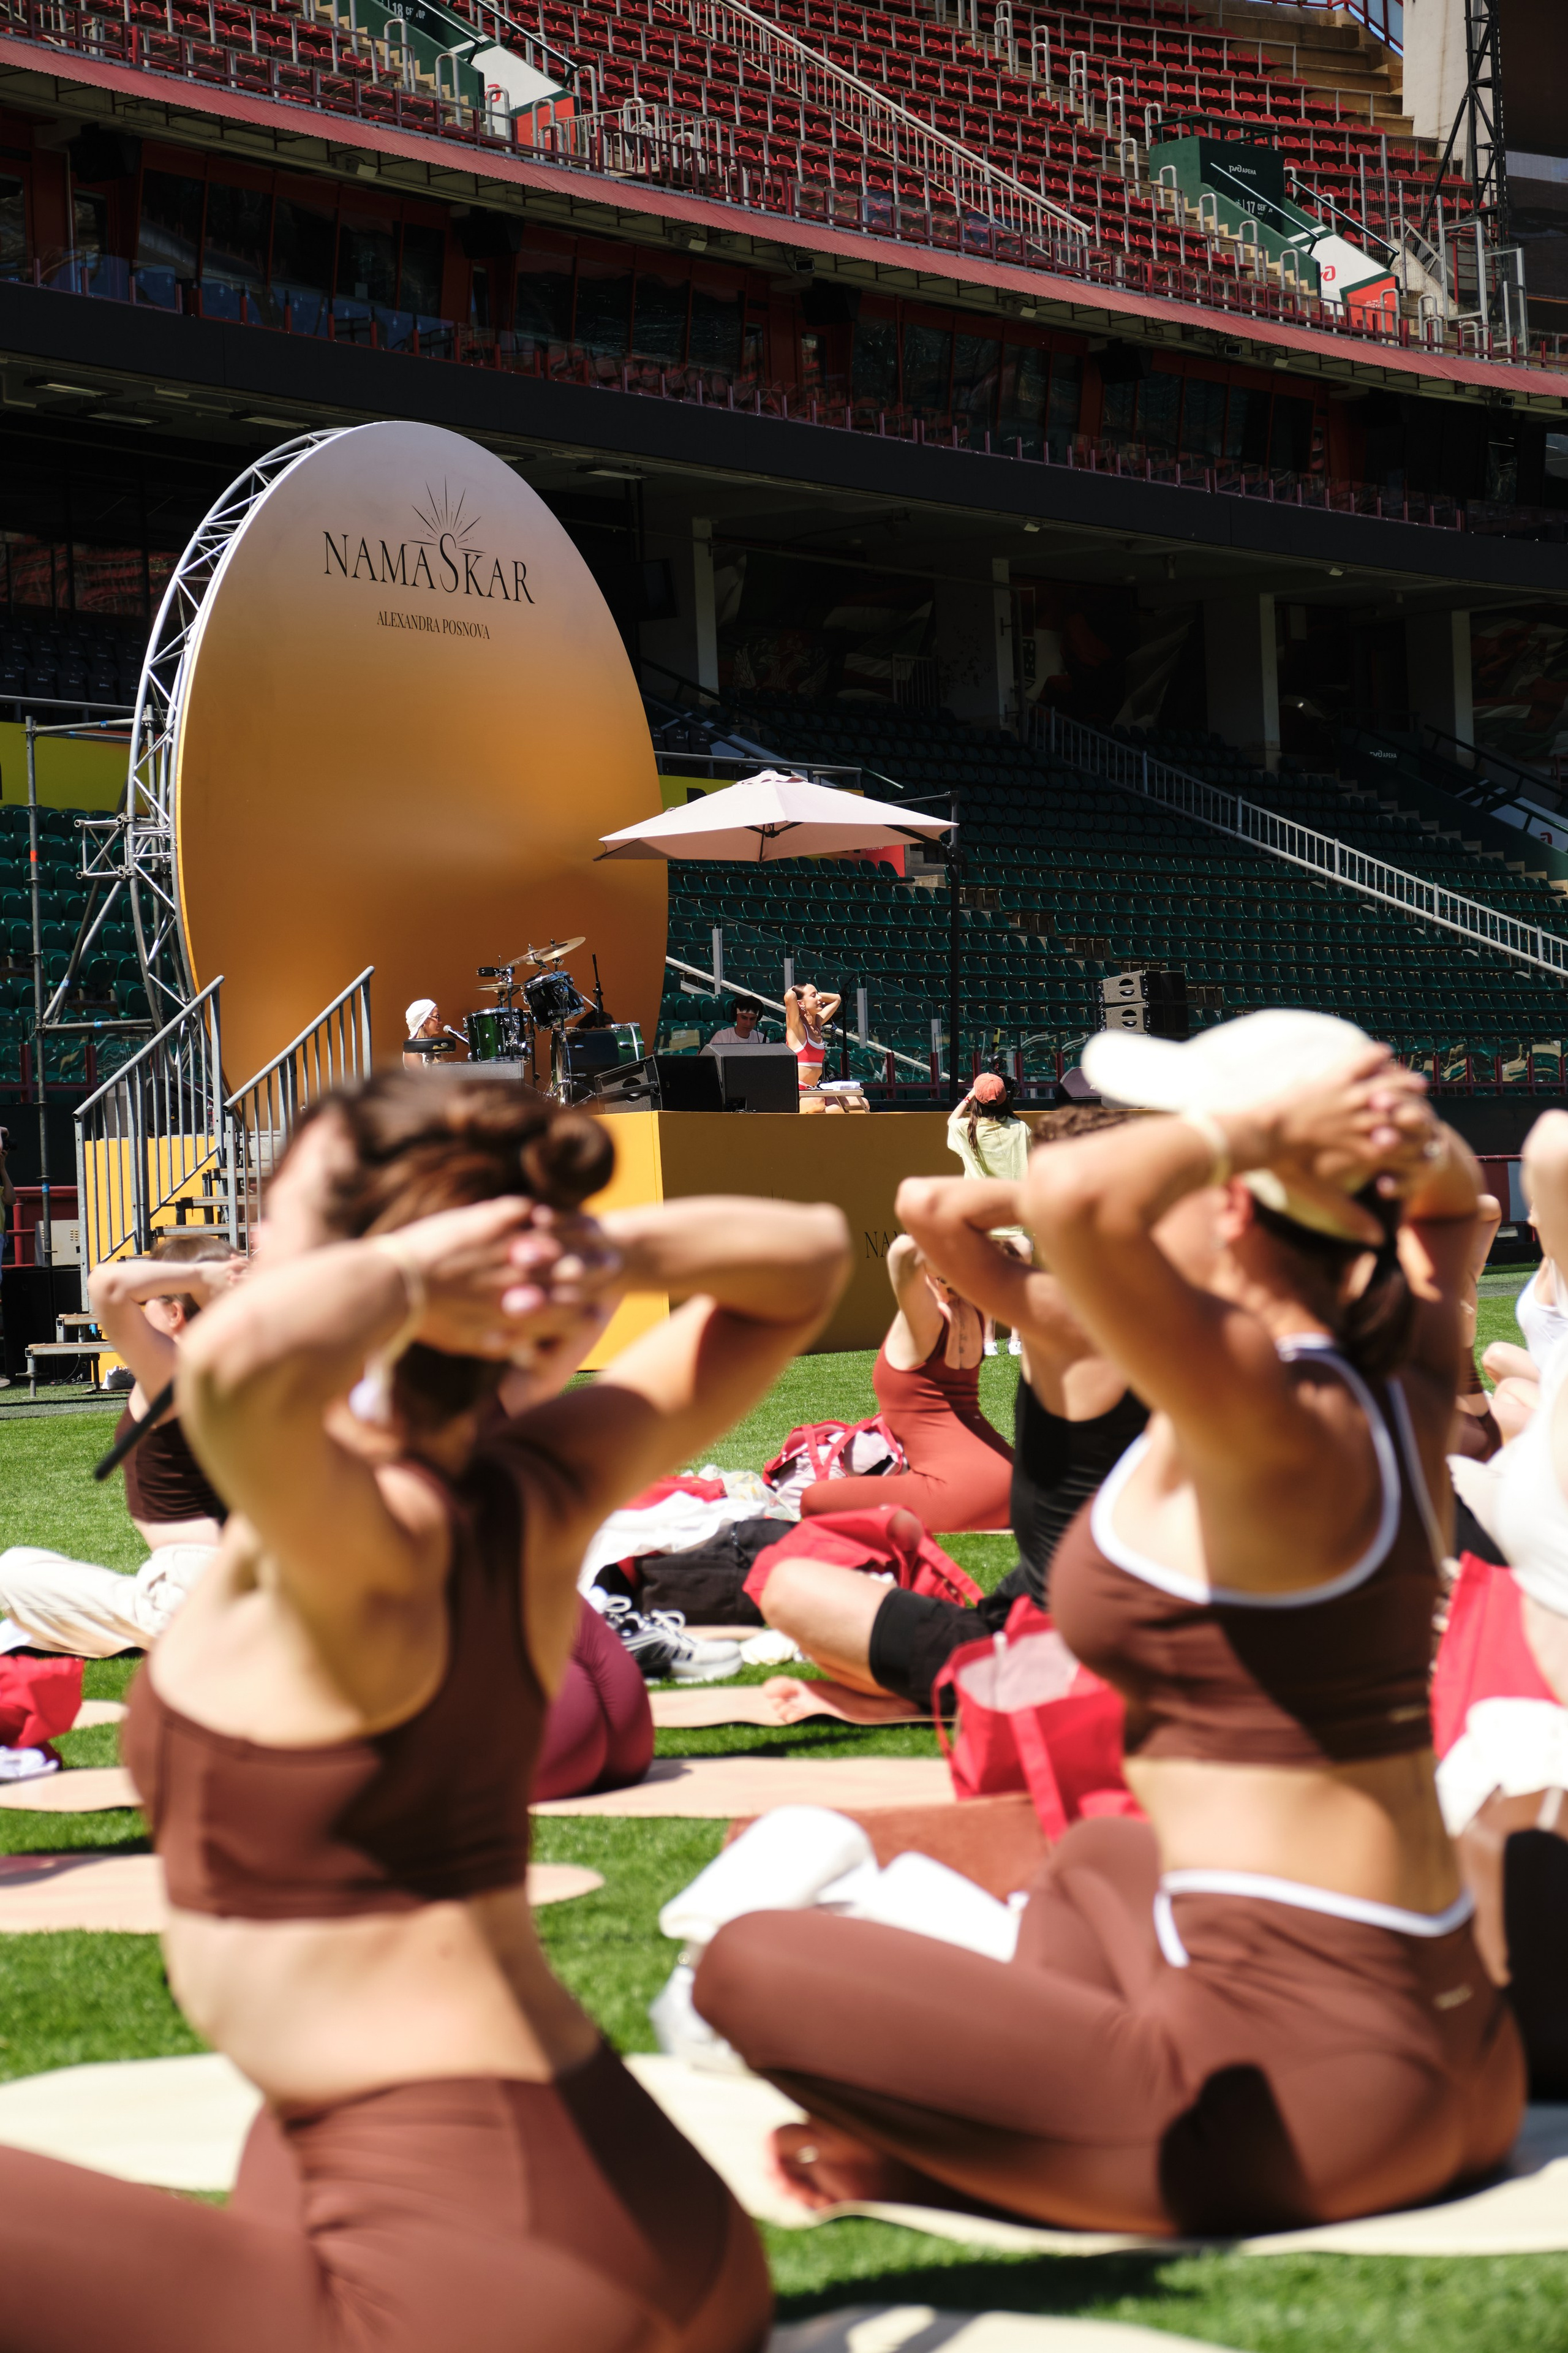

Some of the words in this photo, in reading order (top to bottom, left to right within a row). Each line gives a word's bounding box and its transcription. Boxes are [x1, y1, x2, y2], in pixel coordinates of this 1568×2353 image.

[1246, 200, 1256, 214] 17
[377, 611, 440, 633] ALEXANDRA
[443, 619, 491, 640] POSNOVA
